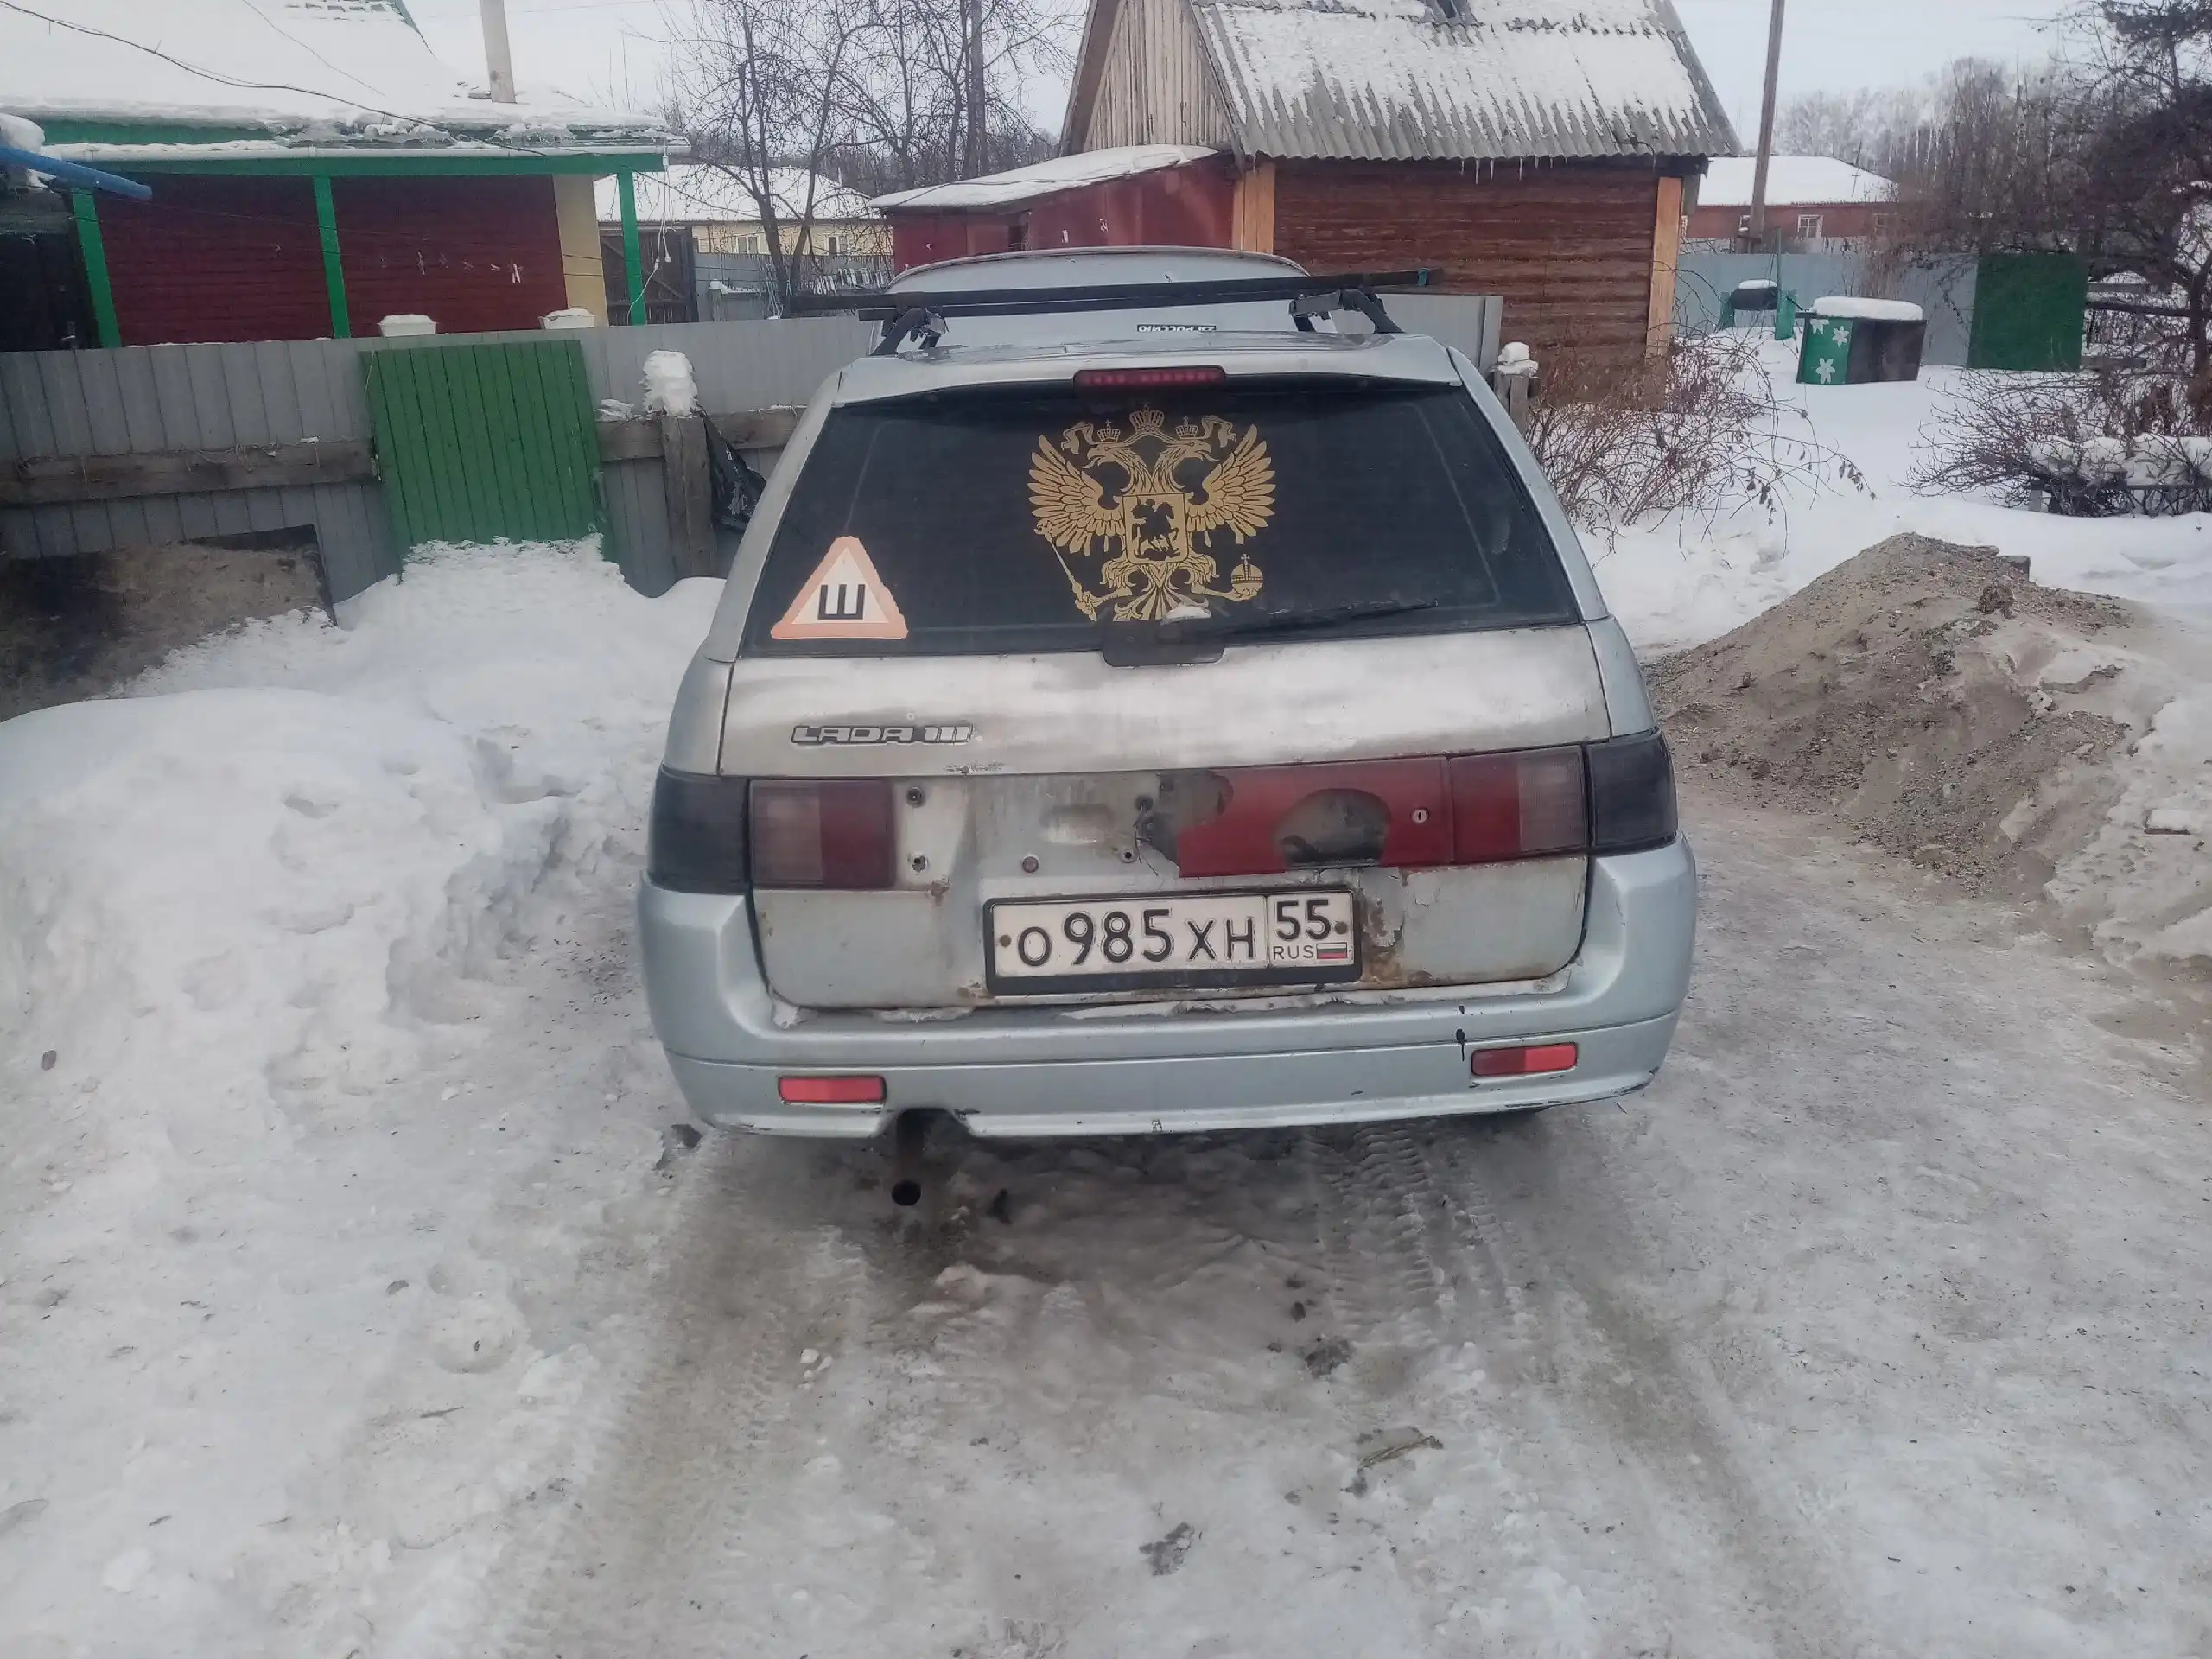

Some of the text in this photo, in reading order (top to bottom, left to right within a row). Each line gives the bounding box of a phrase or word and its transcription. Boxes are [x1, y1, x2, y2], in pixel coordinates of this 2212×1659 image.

[817, 583, 866, 620] Ш
[791, 725, 915, 744] LADA
[1274, 899, 1332, 941] 55
[1273, 943, 1315, 960] RUS
